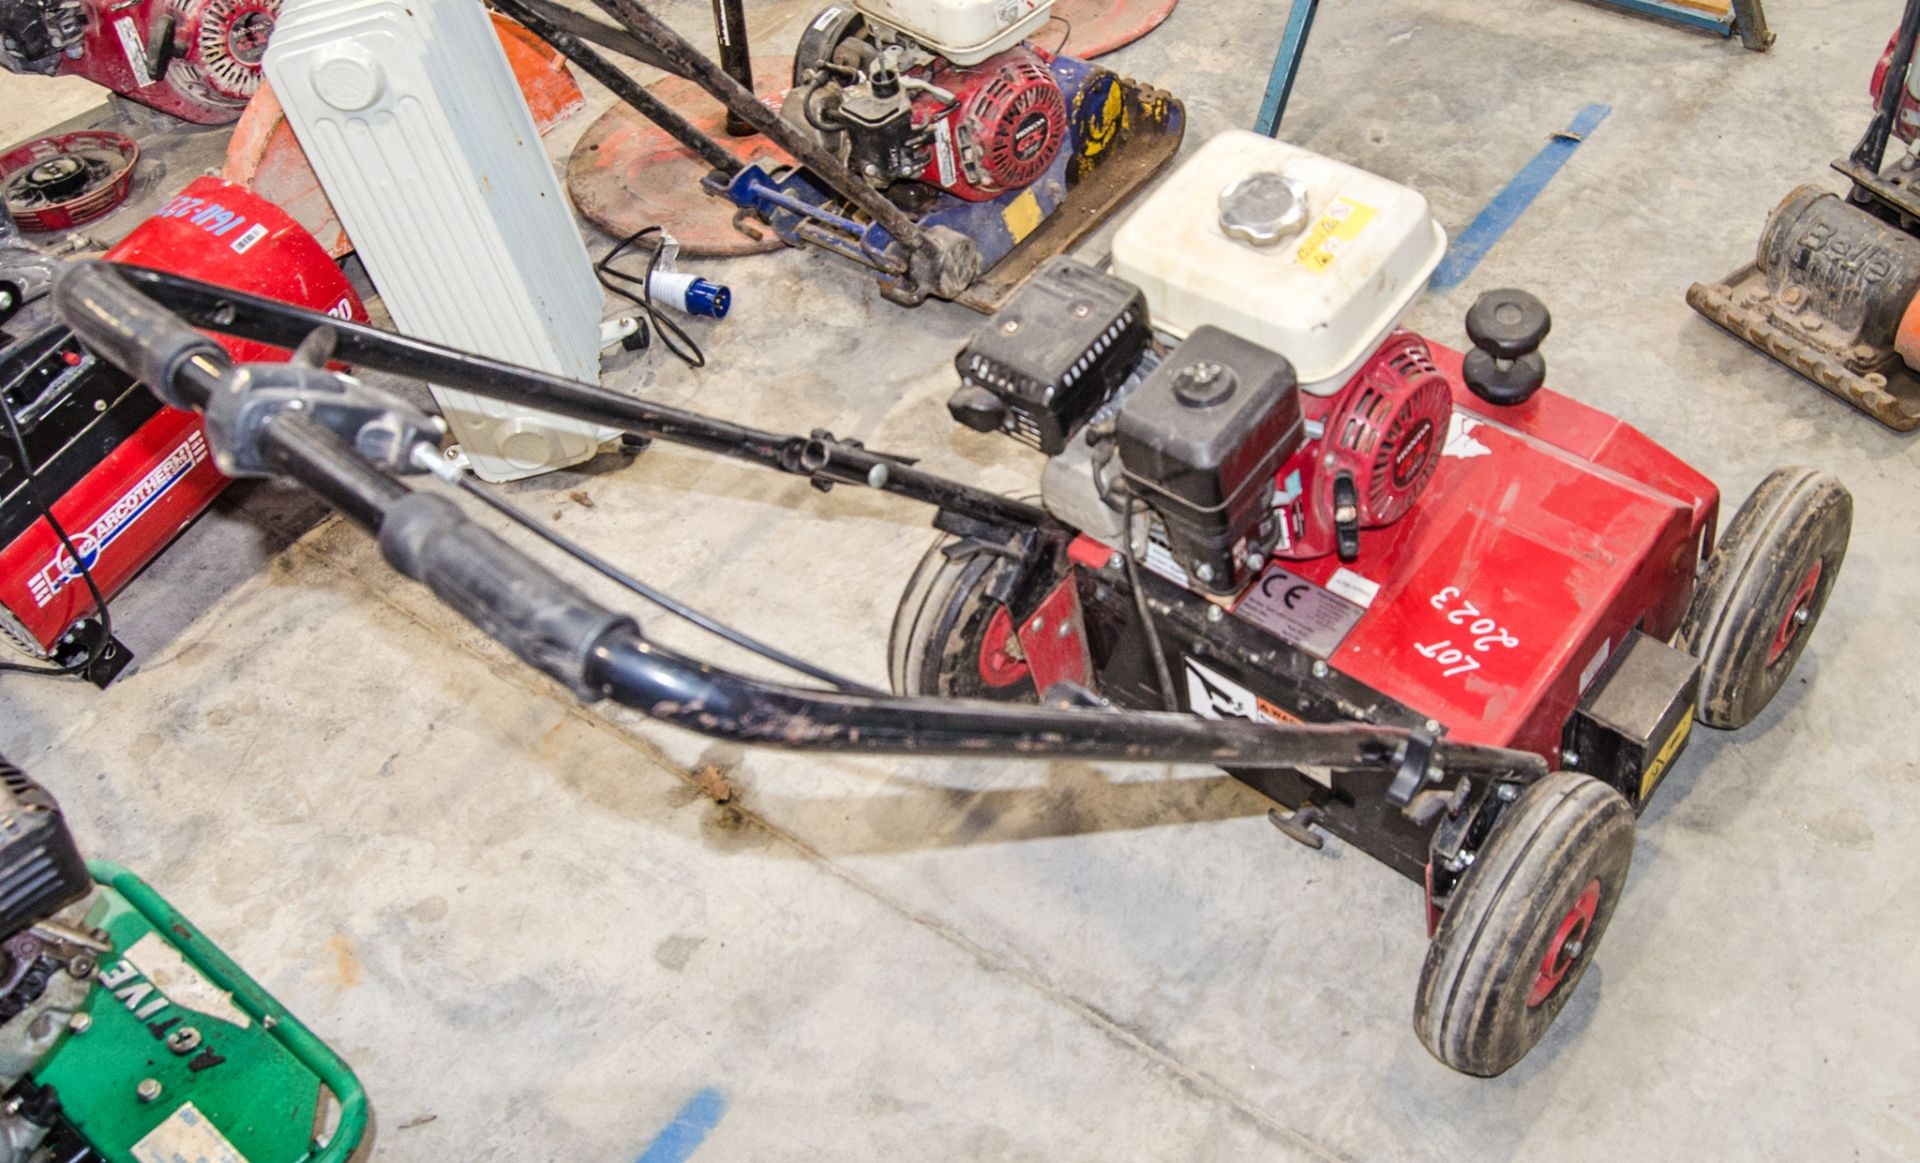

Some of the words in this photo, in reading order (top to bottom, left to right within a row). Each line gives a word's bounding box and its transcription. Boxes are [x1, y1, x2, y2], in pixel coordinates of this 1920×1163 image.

[1796, 221, 1892, 284] Belle
[94, 445, 190, 540] ARCOTHERM
[1429, 586, 1520, 652] 2023
[1413, 639, 1481, 677] LOT
[97, 959, 226, 1074] ACTIVE
